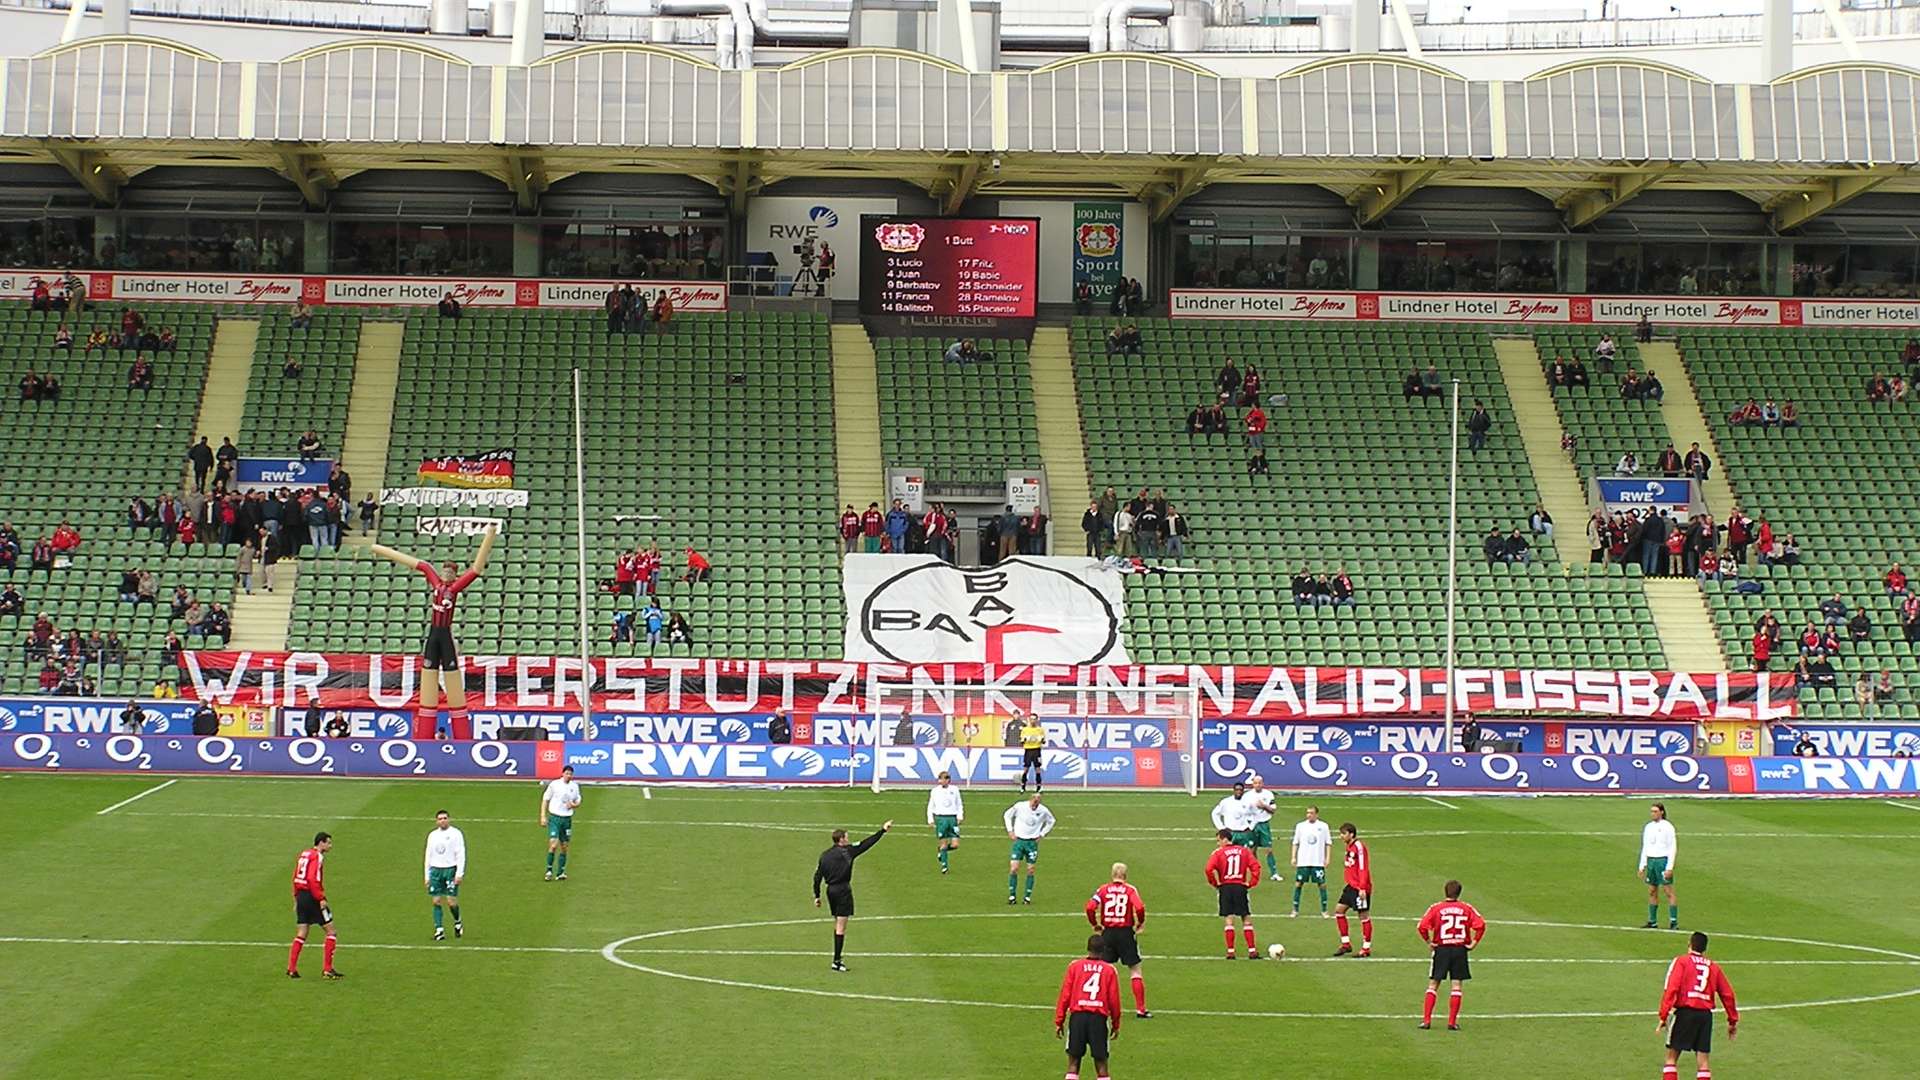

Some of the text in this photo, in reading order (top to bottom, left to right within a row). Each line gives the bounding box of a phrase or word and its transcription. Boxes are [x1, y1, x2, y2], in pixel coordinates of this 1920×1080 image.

[1077, 210, 1121, 219] 100 Jahre
[770, 225, 819, 239] RWE
[945, 236, 974, 245] 1 Butt
[886, 269, 921, 278] 4 Juan
[887, 257, 894, 267] 3
[958, 259, 970, 268] 17
[1076, 258, 1120, 273] Sport
[122, 275, 292, 300] Lindner Hotel BayArena
[334, 282, 394, 298] Lindner
[399, 283, 443, 299] Hotel
[547, 287, 607, 301] Lindner
[881, 292, 930, 300] 11 Franca
[887, 280, 941, 289] 9 Berbatov
[973, 281, 1023, 290] Schneider
[881, 303, 934, 312] 14 Balitsch
[958, 293, 1020, 302] 28 Ramelow
[958, 304, 1016, 313] 35 Placente
[1175, 296, 1345, 318] Lindner Hotel BayArena
[1388, 299, 1559, 321] Lindner Hotel BayArena
[1600, 302, 1769, 323] Lindner Hotel BayArena
[1812, 304, 1919, 320] Lindner Hotel
[261, 471, 296, 482] RWE
[1620, 491, 1655, 502] RWE
[369, 653, 954, 714] UTERSTÜTZEN
[984, 663, 1235, 716] KEINEN
[1247, 666, 1792, 720] ALIBI-FUSSBALL
[473, 714, 565, 741] RWE
[625, 716, 717, 743] RWE
[815, 719, 899, 746] RWE
[1041, 722, 1132, 749] RWE
[1228, 724, 1320, 750] RWE
[1380, 726, 1466, 752] RWE
[14, 733, 61, 767] O2
[105, 735, 152, 769] O2
[197, 737, 243, 771] O2
[1566, 728, 1657, 755] RWE
[1807, 731, 1892, 757] RWE
[288, 737, 334, 772] O2
[379, 739, 426, 774] O2
[471, 740, 518, 775] O2
[569, 755, 600, 764] RWE
[613, 743, 767, 777] RWE
[830, 758, 861, 768] RWE
[879, 746, 1025, 780] RWE
[1090, 762, 1121, 771] RWE
[1209, 750, 1257, 785] O2
[1300, 751, 1348, 786] O2
[1391, 752, 1439, 787] O2
[1481, 753, 1529, 788] O2
[1571, 754, 1620, 789] O2
[1661, 755, 1710, 790] O2
[1760, 769, 1791, 779] RWE
[1226, 854, 1241, 876] 11
[1104, 892, 1129, 917] 28
[1440, 914, 1468, 940] 25
[1082, 971, 1101, 1001] 4
[1694, 964, 1710, 992] 3
